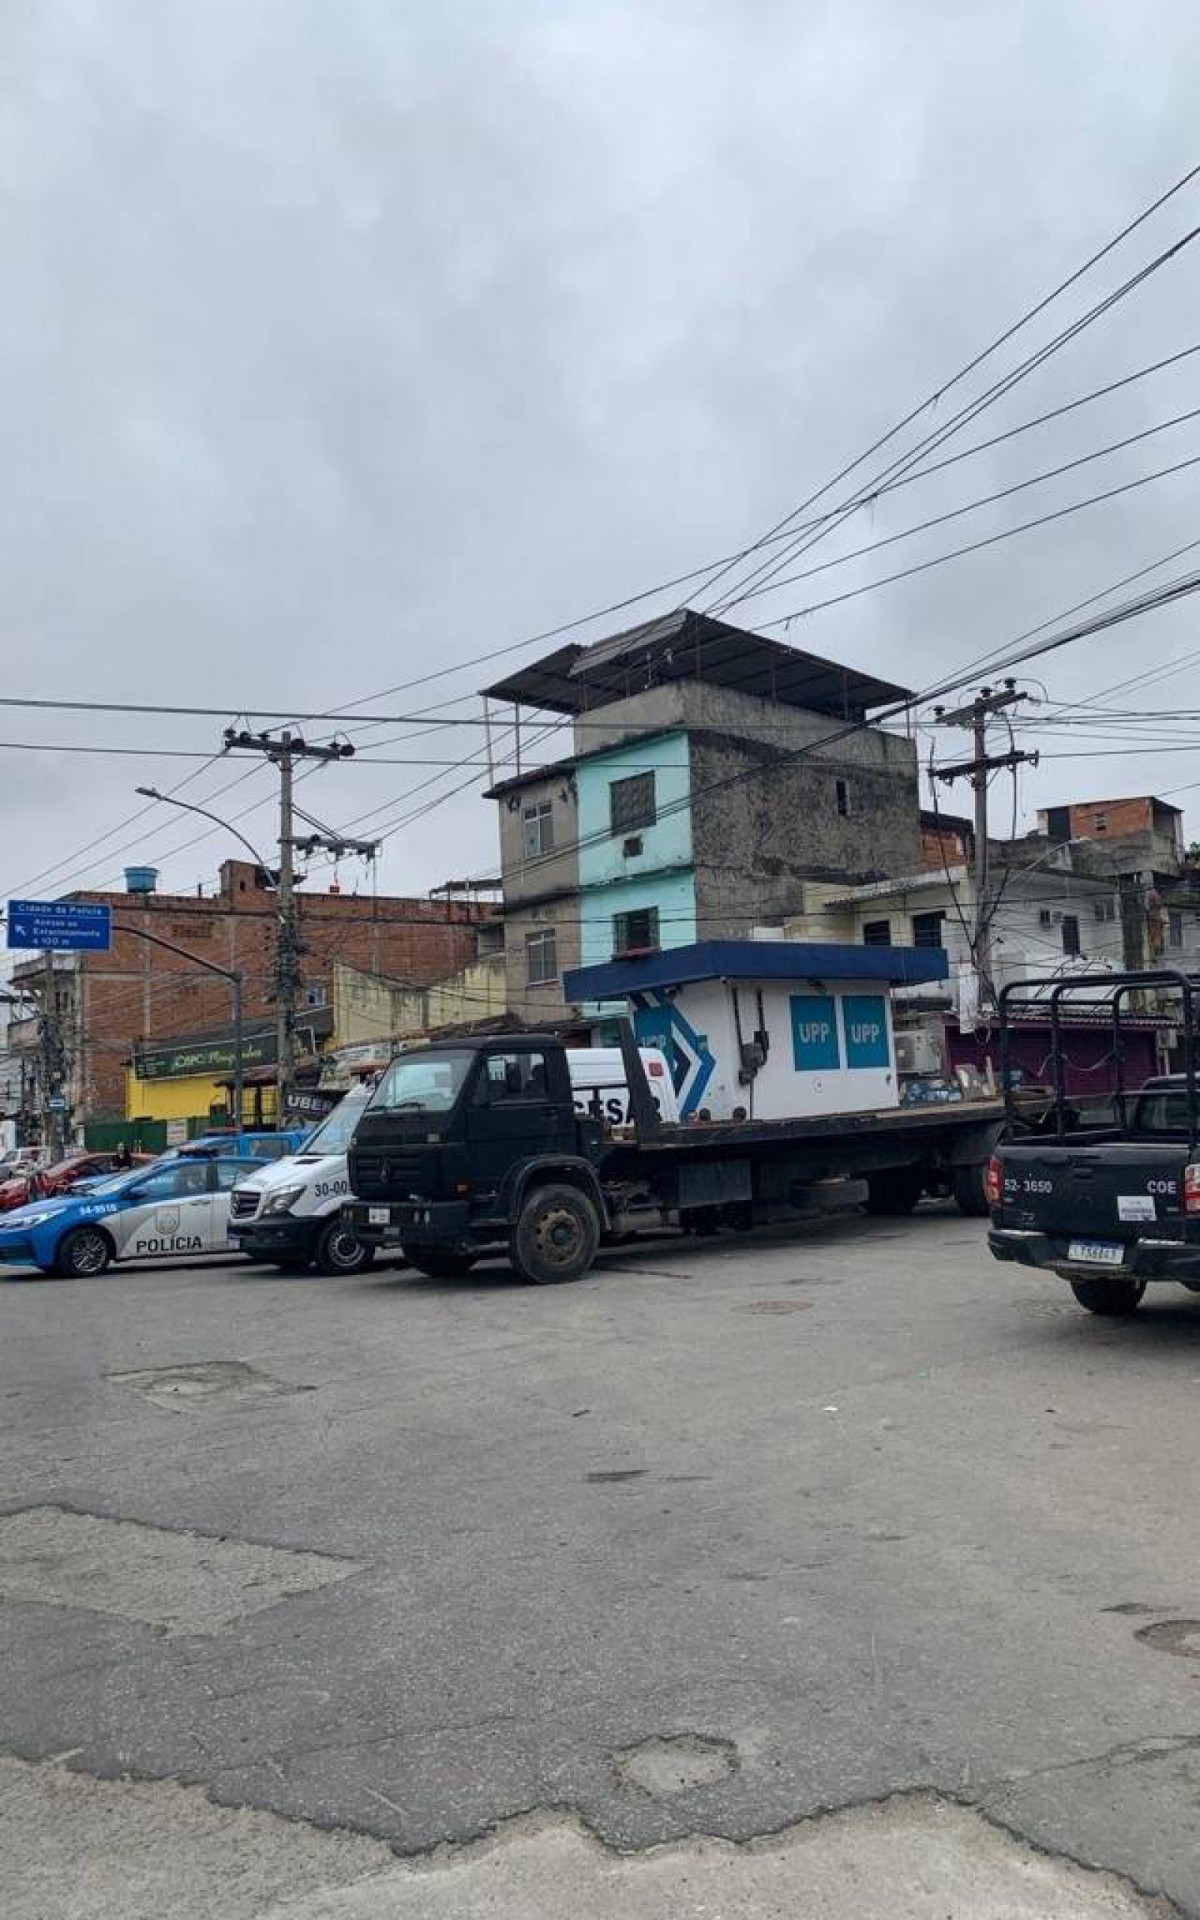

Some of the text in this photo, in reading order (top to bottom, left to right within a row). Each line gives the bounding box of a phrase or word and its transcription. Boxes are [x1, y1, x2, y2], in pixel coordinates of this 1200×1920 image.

[18, 903, 52, 913] Cidade
[55, 906, 67, 914] da
[798, 1022, 830, 1043] UPP
[850, 1023, 880, 1044] UPP
[314, 1180, 348, 1197] 30-00
[1147, 1180, 1177, 1194] COE
[136, 1235, 203, 1254] POLÍCIA
